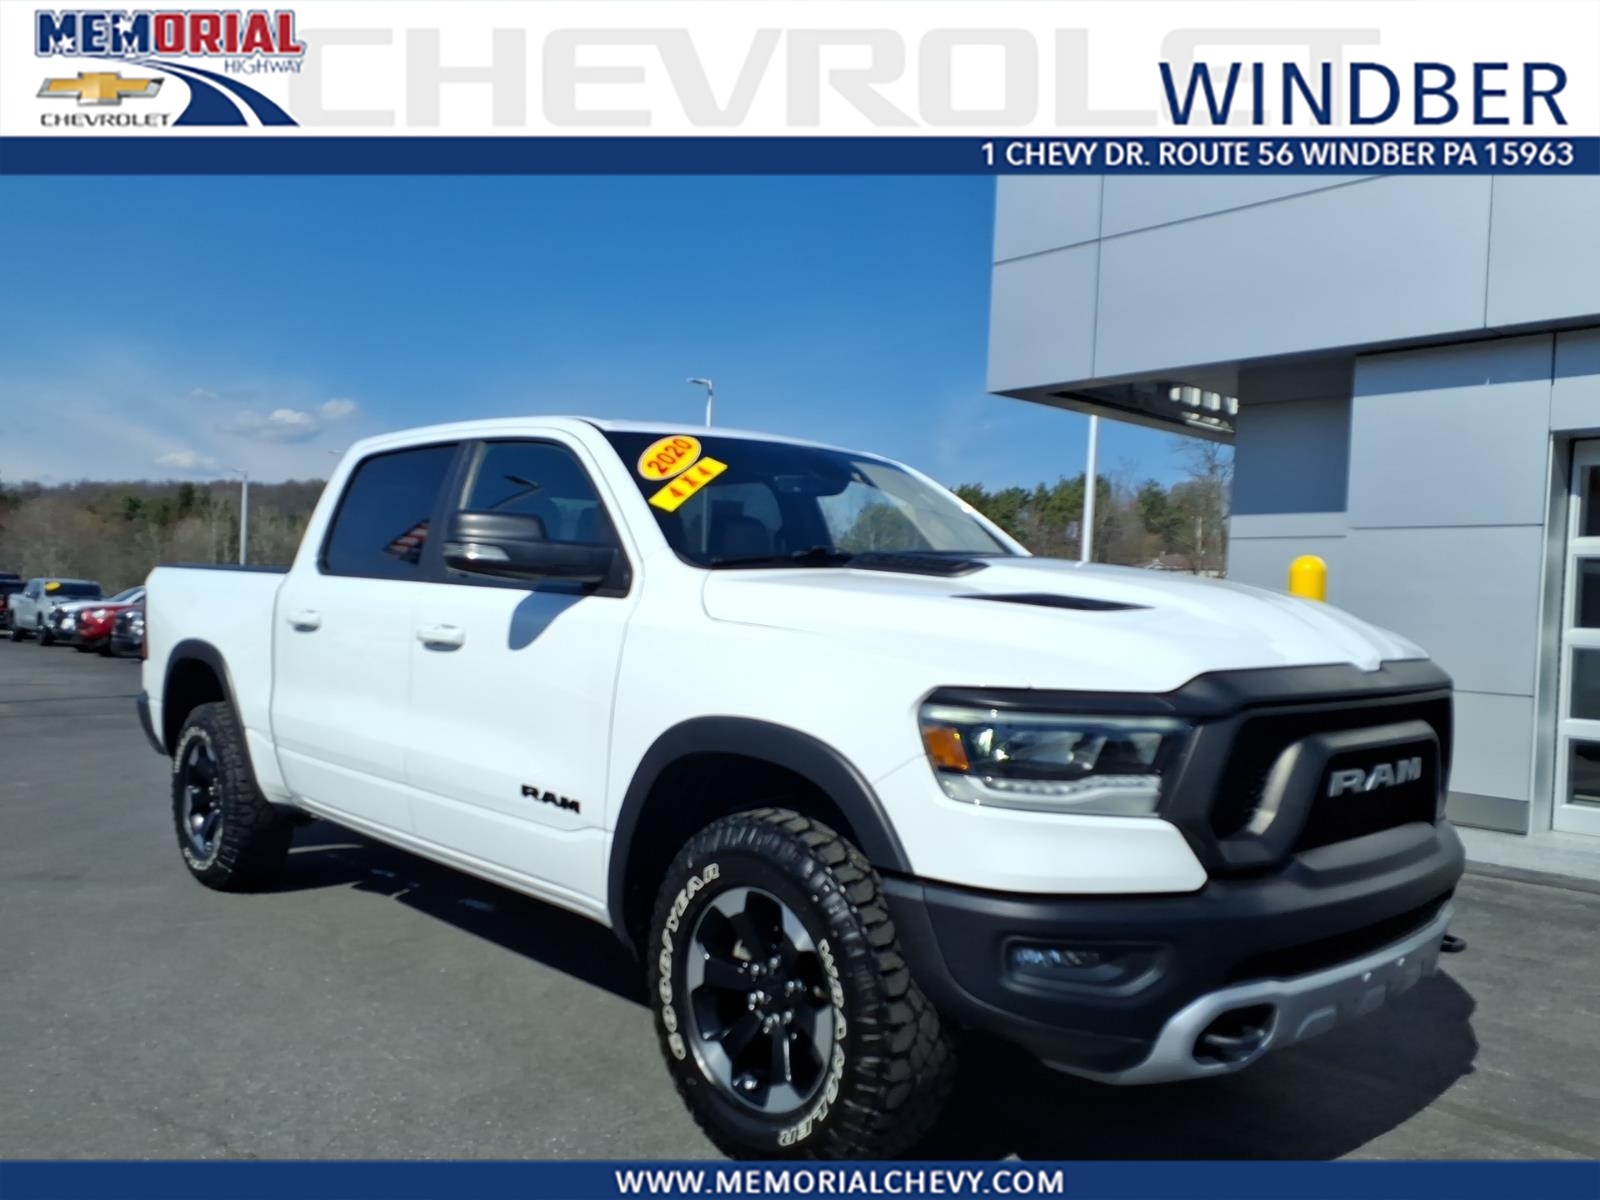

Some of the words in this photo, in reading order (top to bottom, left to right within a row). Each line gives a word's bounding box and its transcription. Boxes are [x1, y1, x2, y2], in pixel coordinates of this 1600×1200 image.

[647, 438, 693, 475] 2020
[1327, 755, 1423, 798] RAM
[520, 783, 581, 815] RAM
[658, 862, 721, 1062] GOODYEAR
